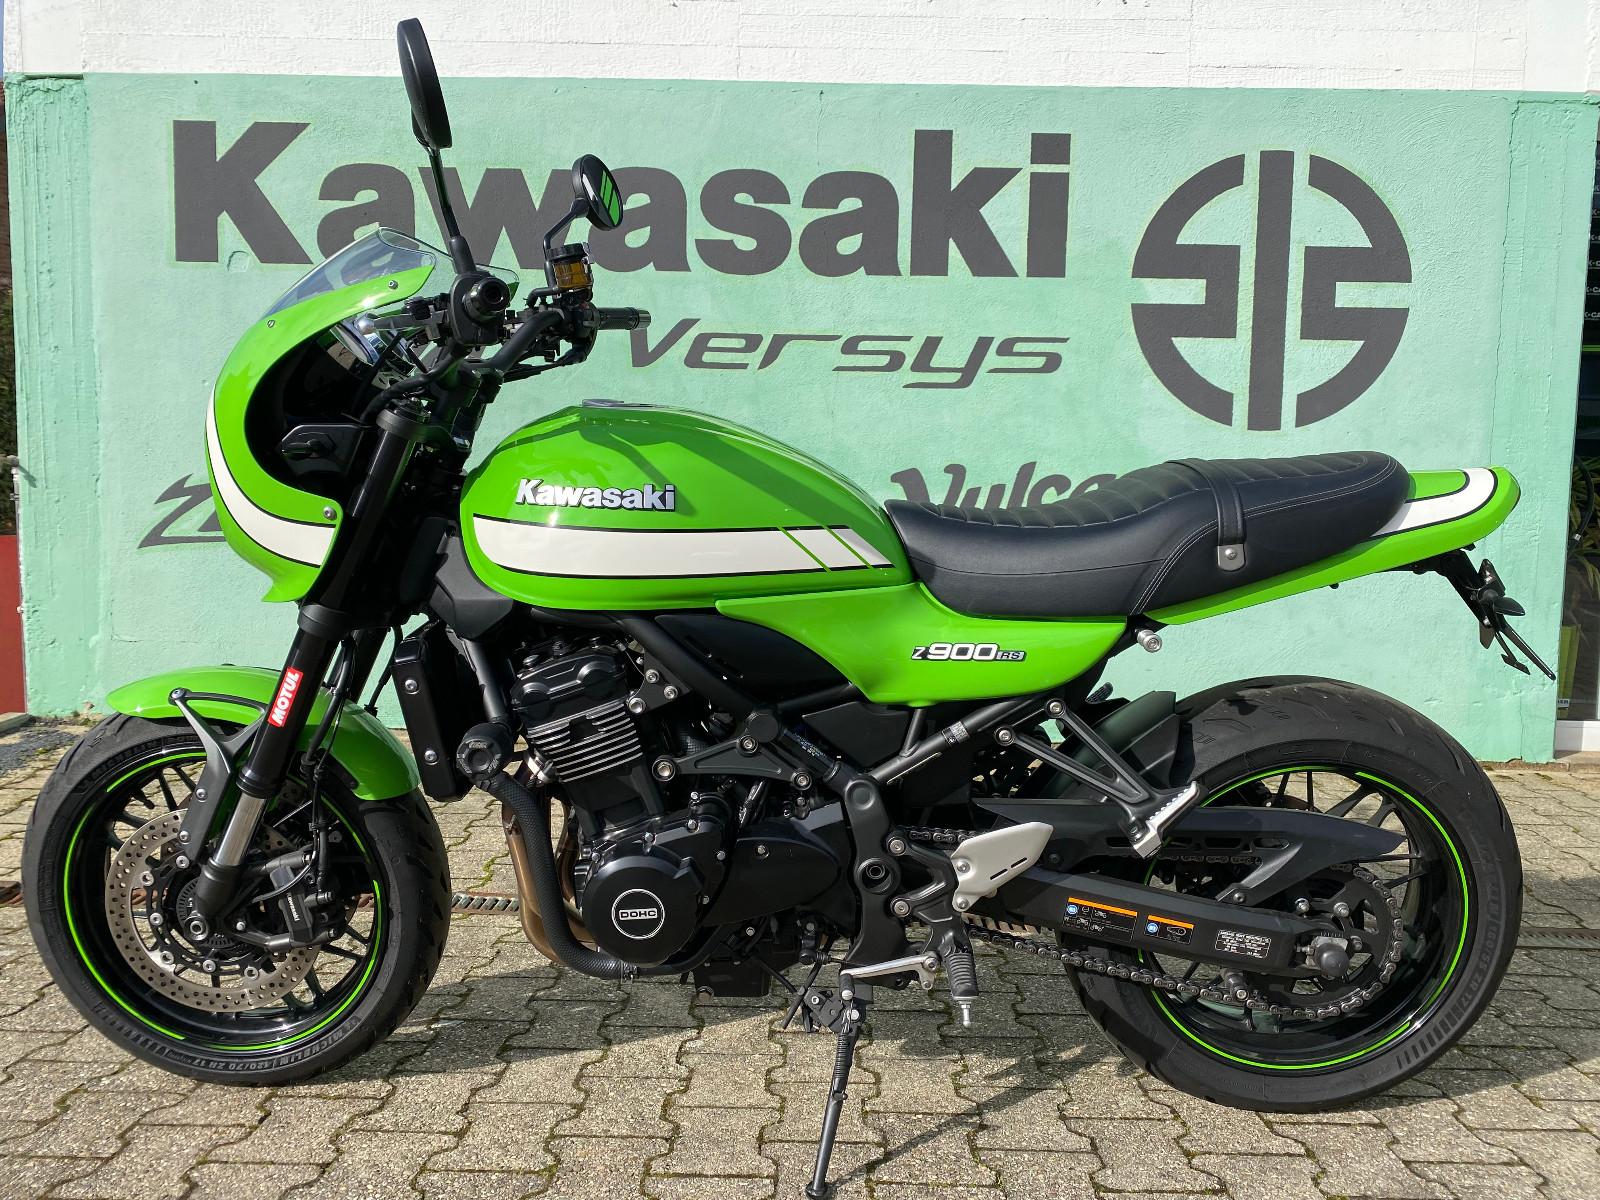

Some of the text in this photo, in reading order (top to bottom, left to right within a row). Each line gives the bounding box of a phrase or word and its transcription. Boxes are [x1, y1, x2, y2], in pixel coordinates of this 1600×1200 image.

[173, 119, 1072, 278] Kawasaki
[630, 318, 1071, 389] Versys
[515, 478, 676, 512] Kawasaki
[271, 671, 300, 726] MOTUL
[620, 909, 657, 919] DOHC
[193, 1058, 207, 1067] 17
[228, 1060, 270, 1071] 120/70
[279, 1030, 344, 1066] MICHELIN
